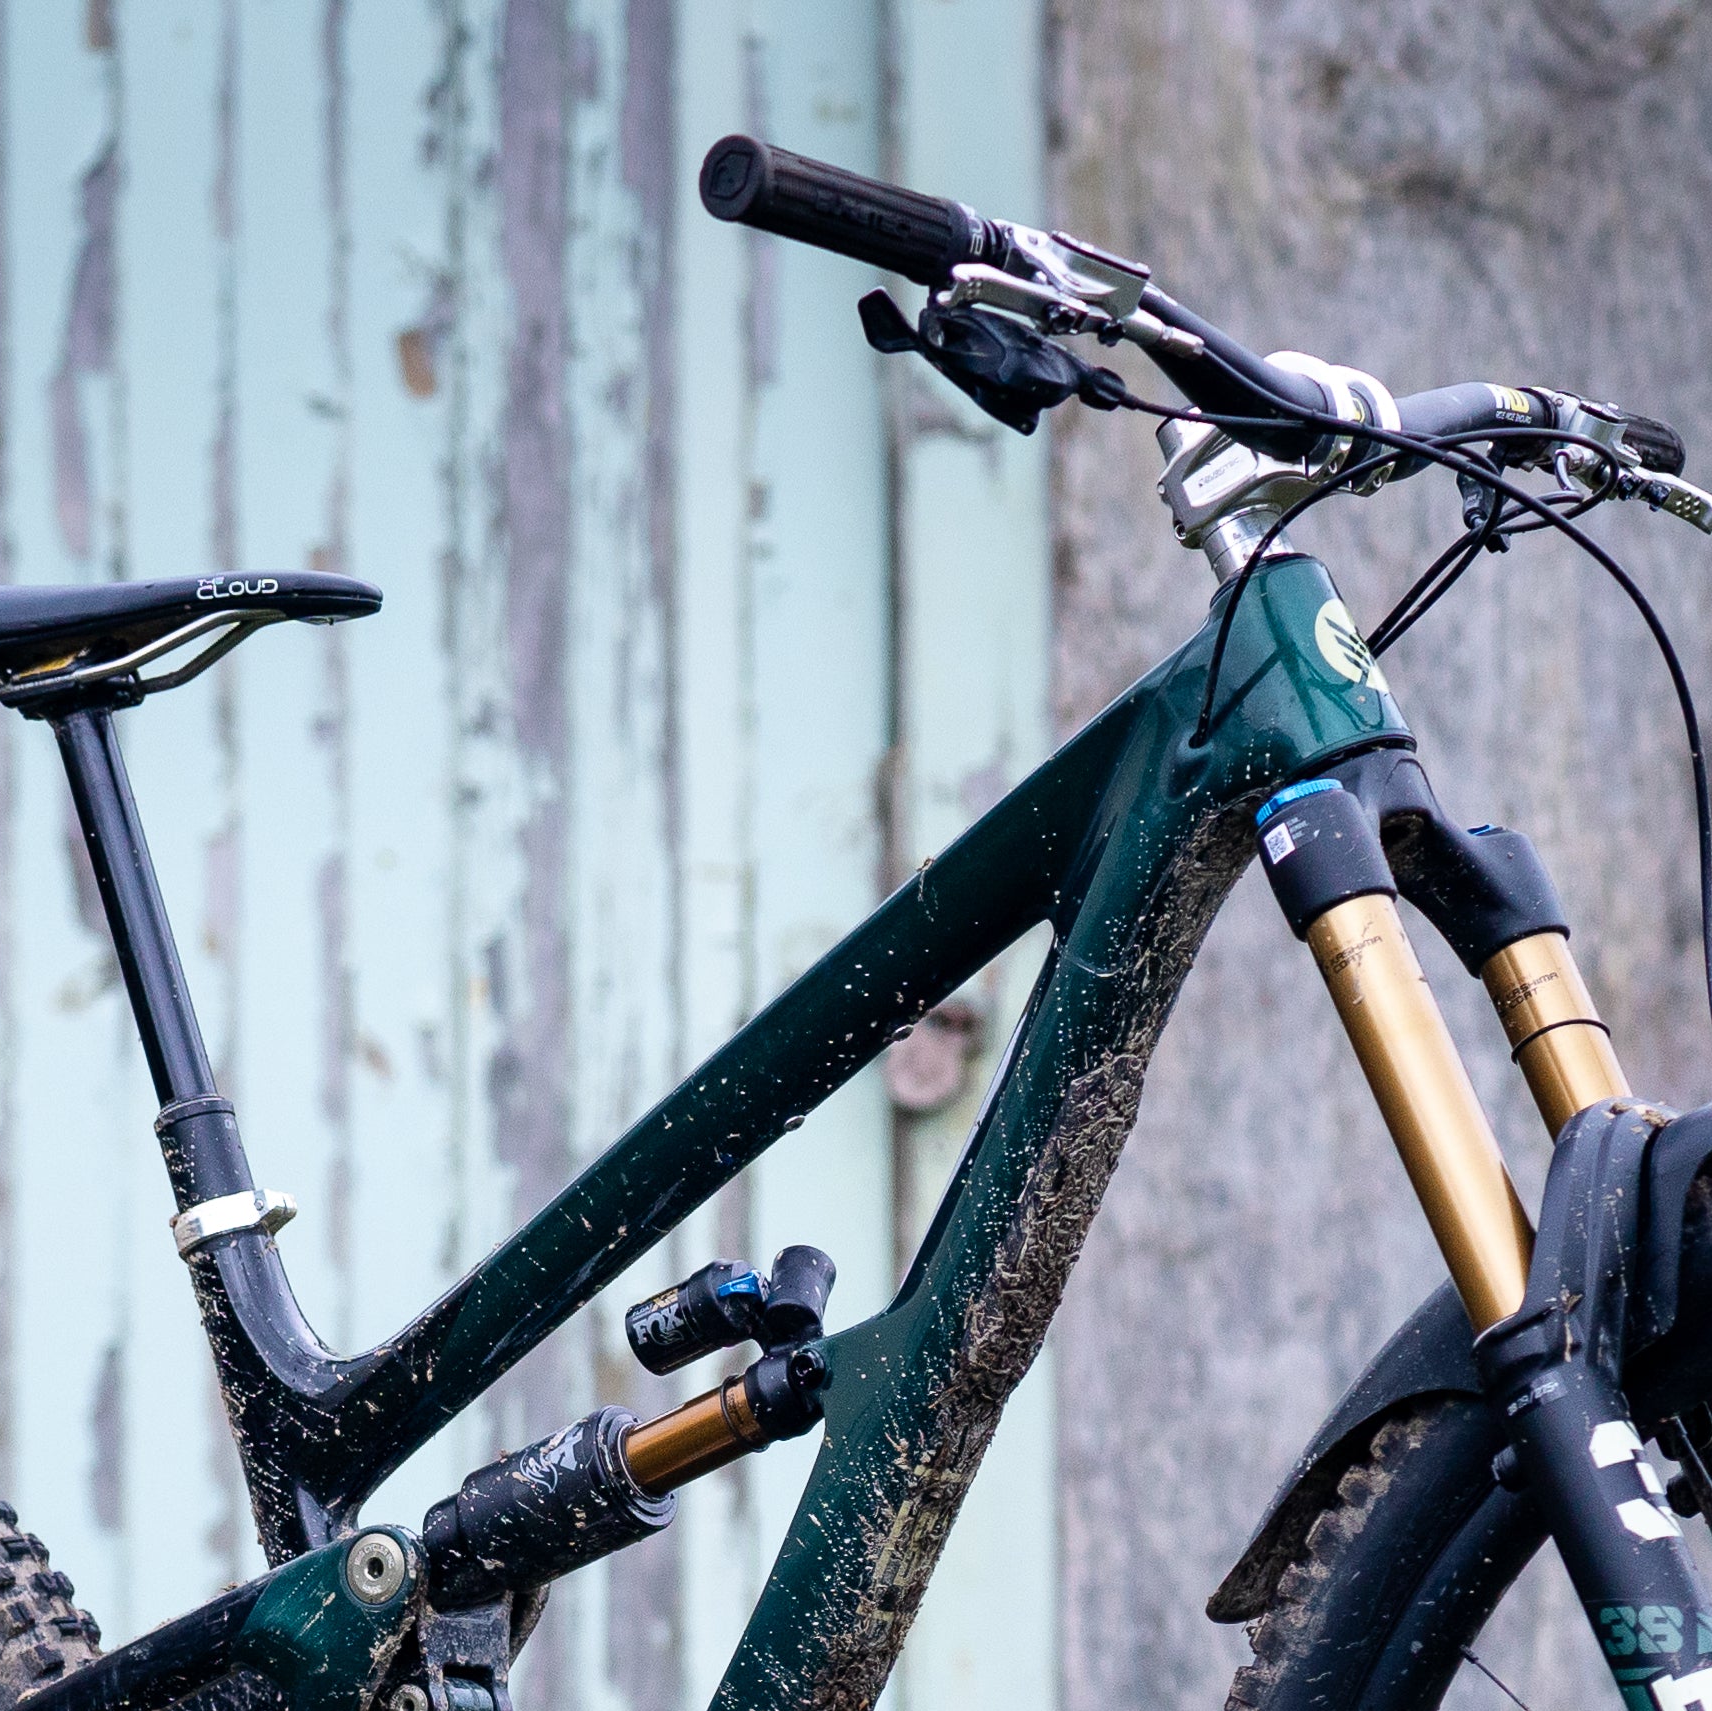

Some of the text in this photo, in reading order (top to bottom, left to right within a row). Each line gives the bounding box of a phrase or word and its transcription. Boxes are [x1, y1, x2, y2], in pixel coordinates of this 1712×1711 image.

[196, 578, 278, 600] CLOUD
[632, 1302, 684, 1346] FOX
[1599, 1606, 1683, 1654] 38
